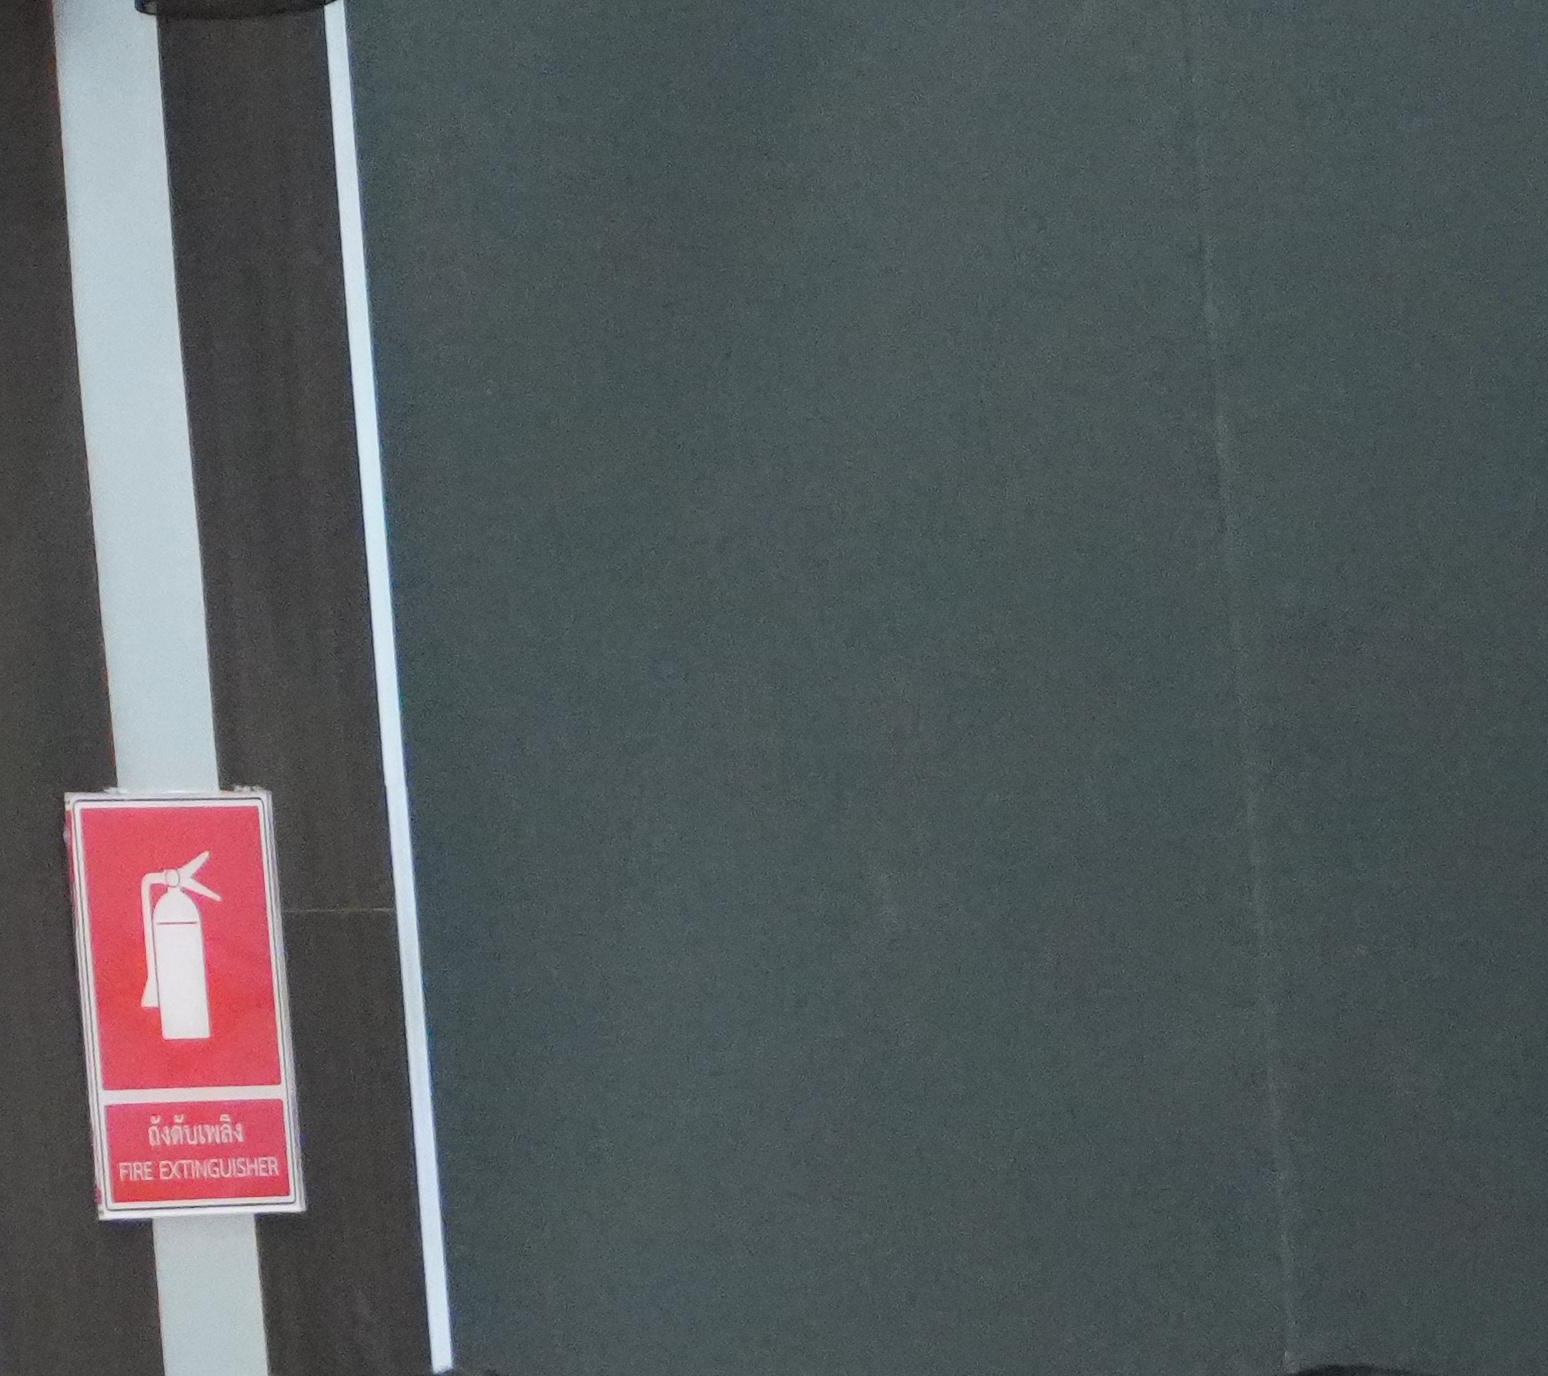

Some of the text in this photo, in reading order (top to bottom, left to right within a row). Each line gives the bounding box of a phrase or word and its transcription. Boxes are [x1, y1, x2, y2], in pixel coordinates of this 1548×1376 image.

[147, 1113, 245, 1147] ถังดับเพลิง
[118, 1156, 281, 1182] FIRE EXTINGUISHER
